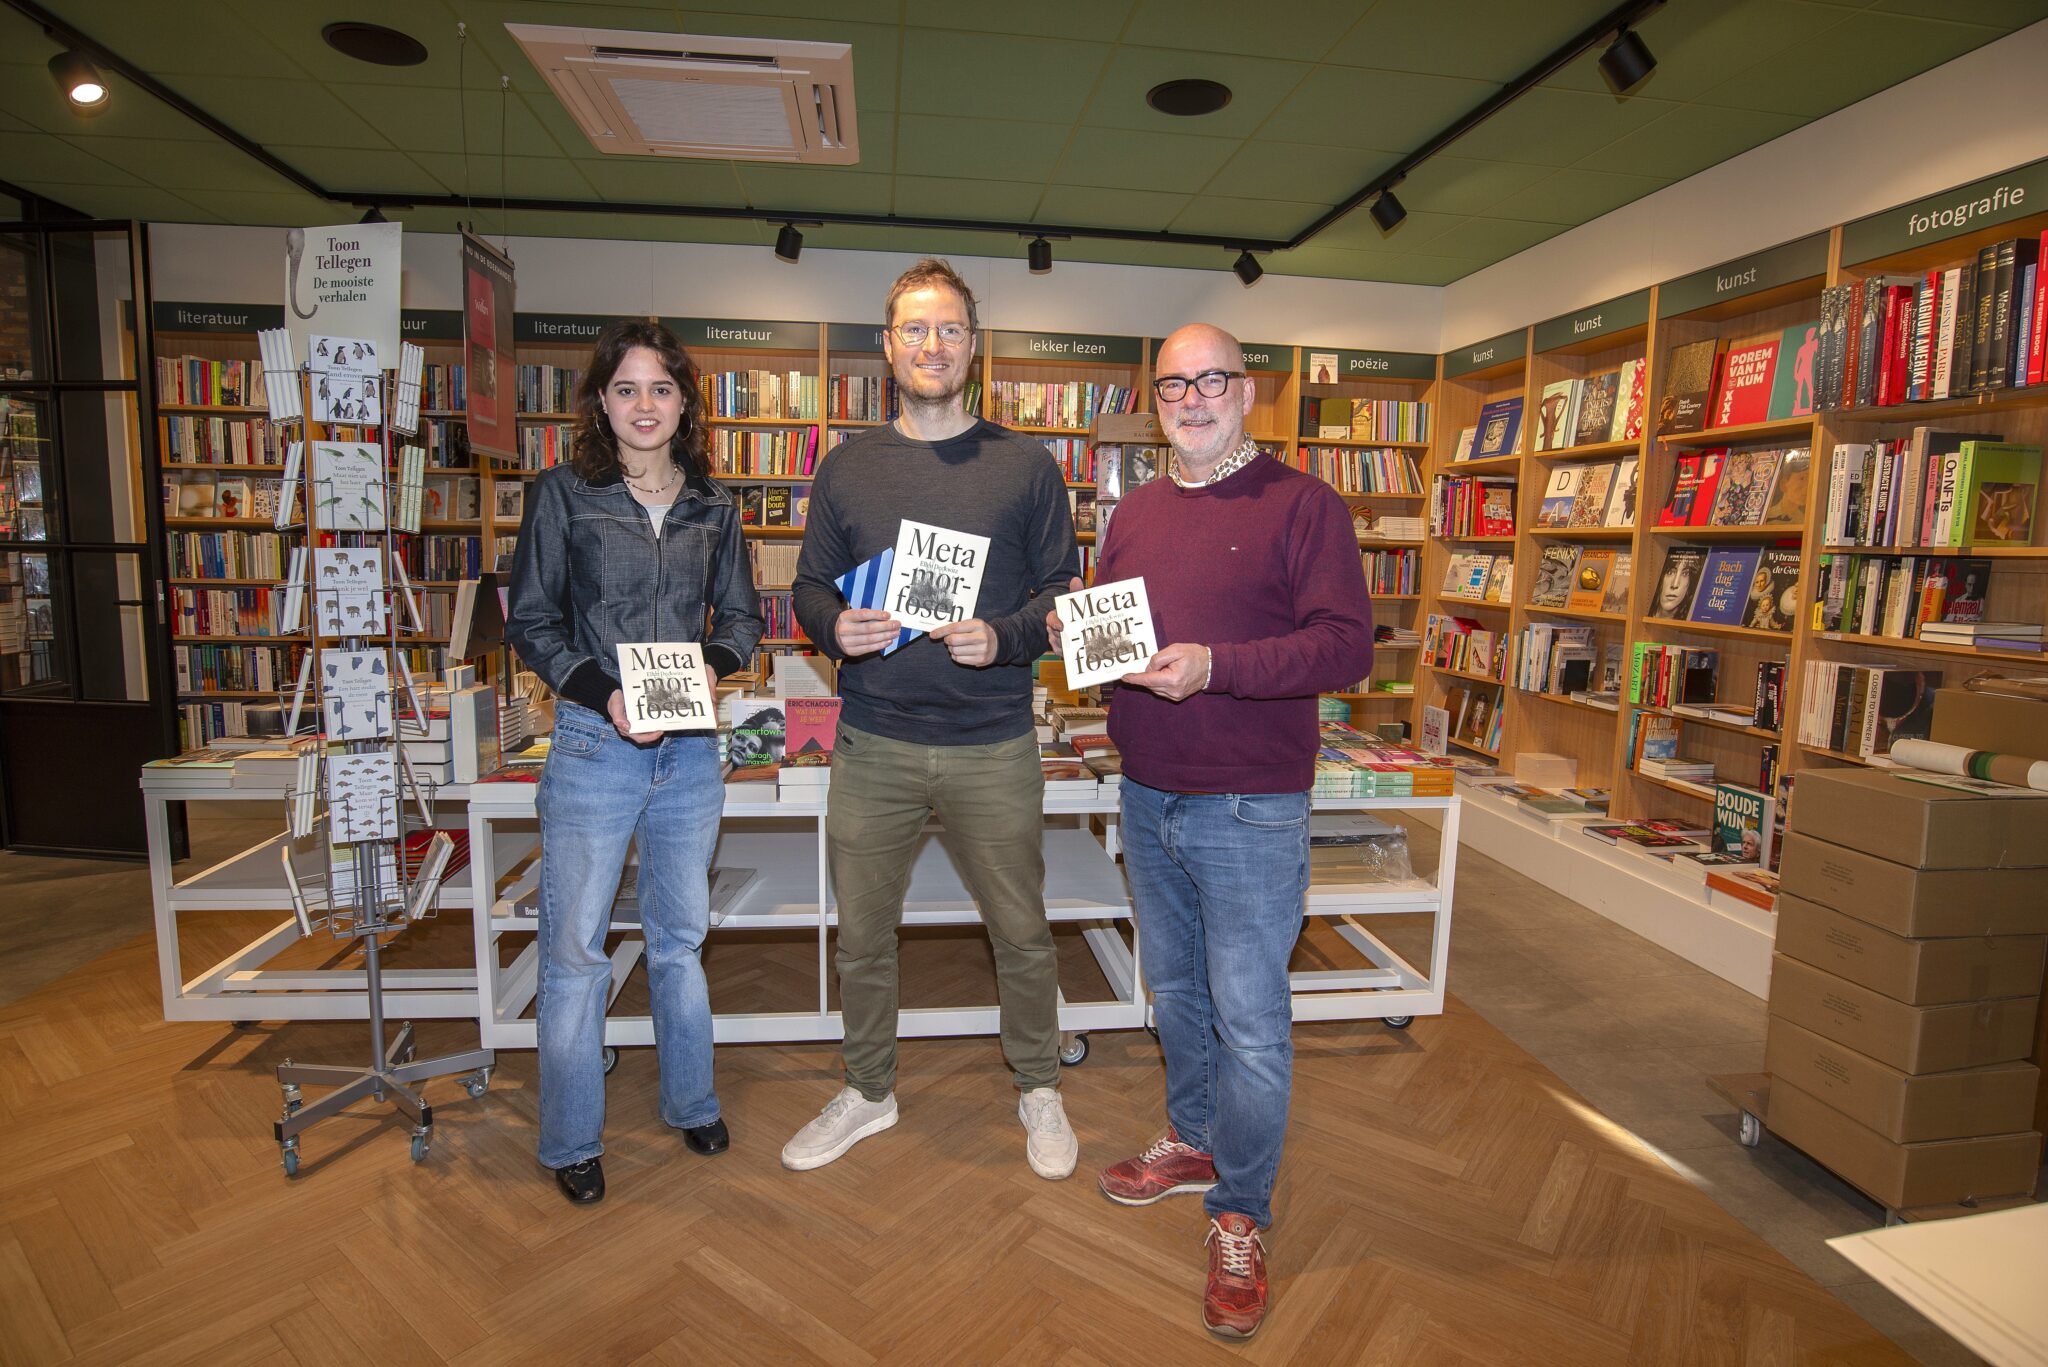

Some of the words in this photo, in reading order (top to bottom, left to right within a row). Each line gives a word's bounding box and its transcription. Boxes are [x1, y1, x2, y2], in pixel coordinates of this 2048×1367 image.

[1908, 186, 2025, 236] fotografie
[327, 237, 360, 252] Toon
[315, 254, 372, 273] Tellegen
[313, 277, 328, 289] De
[330, 275, 374, 288] mooiste
[1715, 268, 1757, 293] kunst
[318, 290, 367, 303] verhalen
[2038, 286, 2046, 302] THE
[177, 310, 249, 327] literatuur
[1916, 288, 1934, 336] MAGNUM
[1940, 288, 1954, 347] DOISNEAU
[1978, 294, 1992, 345] Watches
[1994, 290, 2009, 341] Watches
[534, 320, 602, 336] literatuur
[1573, 313, 1602, 334] kunst
[706, 325, 773, 342] literatuur
[1029, 339, 1069, 353] lekker
[1073, 339, 1107, 354] lezen
[2033, 334, 2041, 356] BOOK
[1350, 357, 1389, 371] poëzie
[1472, 348, 1494, 364] kunst
[1730, 347, 1773, 366] POREM
[1912, 338, 1930, 386] AMERIKA
[1937, 348, 1948, 381] PARIS
[1730, 363, 1754, 378] VAN
[1756, 360, 1768, 372] M
[1724, 390, 1734, 402] X
[1722, 402, 1732, 412] X
[1720, 413, 1730, 424] X
[1880, 456, 1892, 490] ABSTRACTE
[1945, 459, 1957, 478] On
[1557, 471, 1571, 490] D
[1878, 491, 1889, 512] KUNST
[1940, 480, 1955, 512] NFTs
[1547, 500, 1560, 522] A
[907, 528, 976, 568] Meta
[1544, 547, 1578, 560] FENIX
[1718, 560, 1742, 573] Bach
[1772, 566, 1783, 574] de
[901, 566, 971, 595] -mor-
[1714, 572, 1734, 587] dag
[1711, 586, 1724, 596] na
[894, 585, 964, 622] fosen
[1068, 591, 1138, 622] Meta
[1708, 596, 1727, 610] dag
[1072, 616, 1143, 646] -mor-
[630, 647, 696, 670] Meta
[1075, 640, 1149, 674] fosen
[1632, 652, 1641, 692] MOZART
[632, 676, 700, 694] -mor-
[1870, 674, 1880, 699] CLOSER
[636, 695, 706, 720] fosen
[1868, 701, 1876, 710] TO
[735, 727, 782, 736] sugartown
[1647, 718, 1672, 730] RADIO
[1864, 710, 1874, 742] VERMEER
[1717, 790, 1760, 818] BOUDE
[1717, 808, 1746, 830] WIJN
